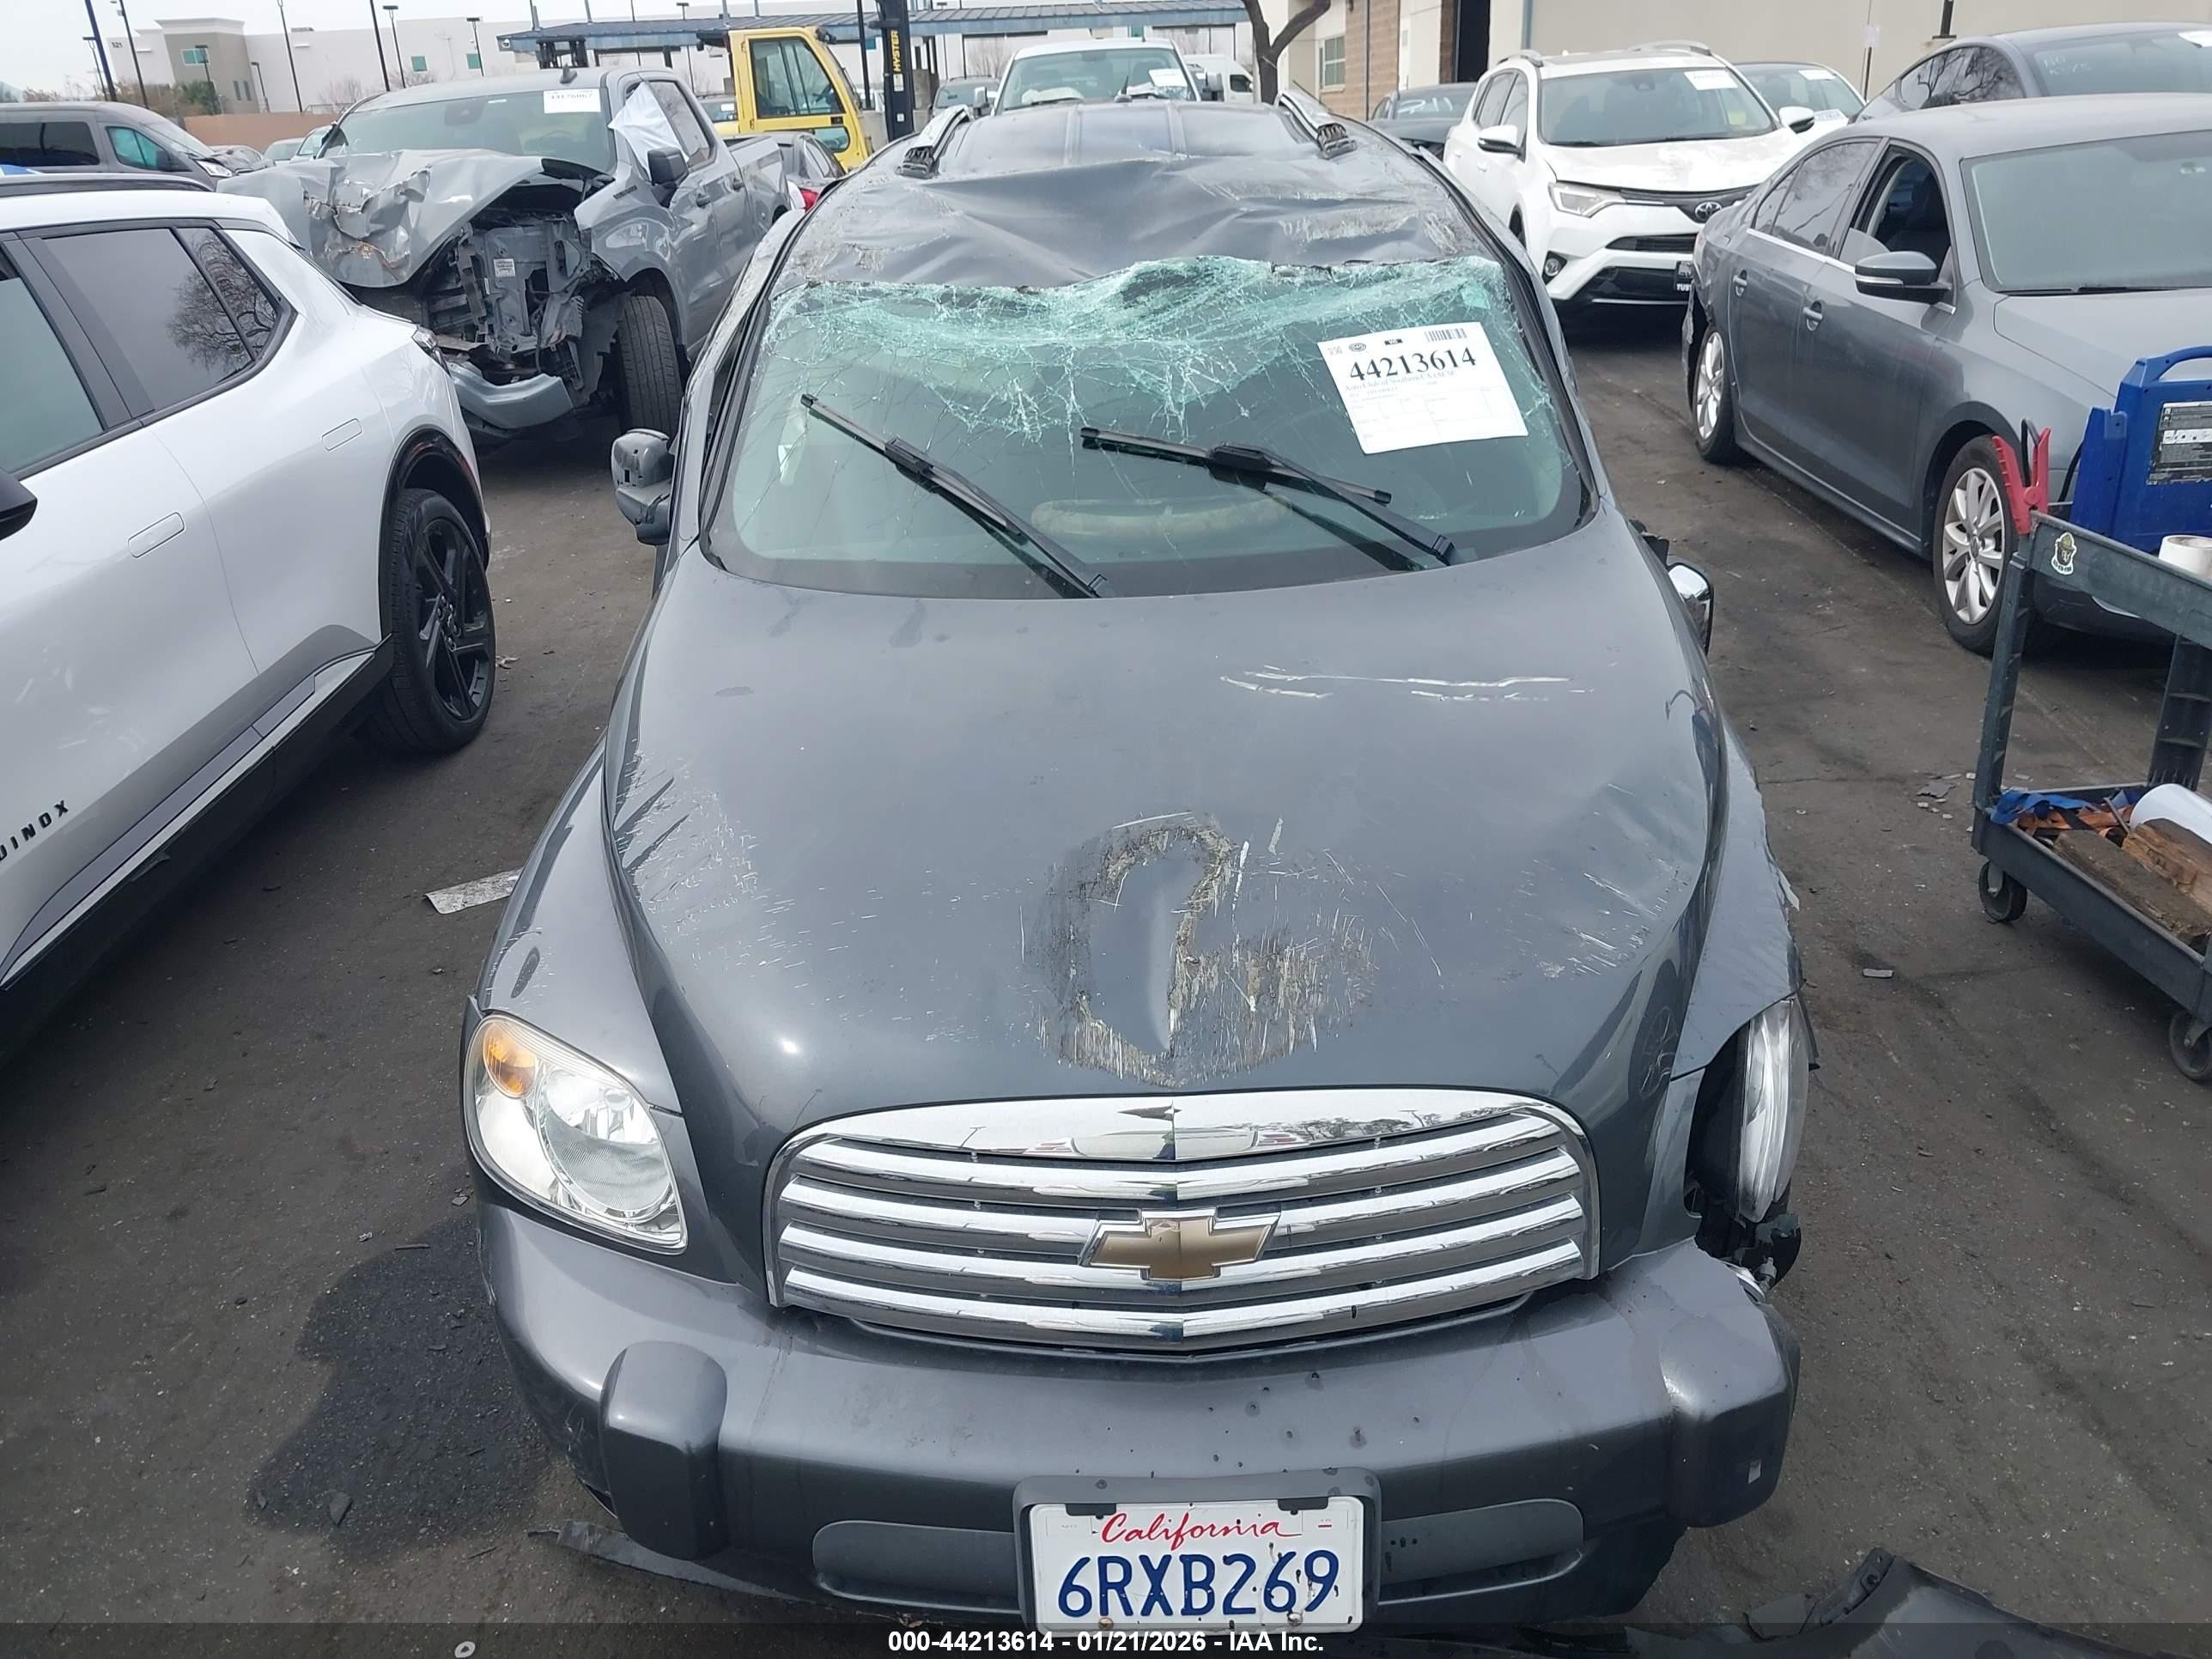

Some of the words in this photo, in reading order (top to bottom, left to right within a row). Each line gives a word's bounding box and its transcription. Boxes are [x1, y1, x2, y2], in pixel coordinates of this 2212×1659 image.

[890, 29, 902, 72] HYSTER
[1350, 347, 1476, 380] 44213614
[1101, 1512, 1302, 1552] California
[1058, 1549, 1340, 1619] 6RXB269
